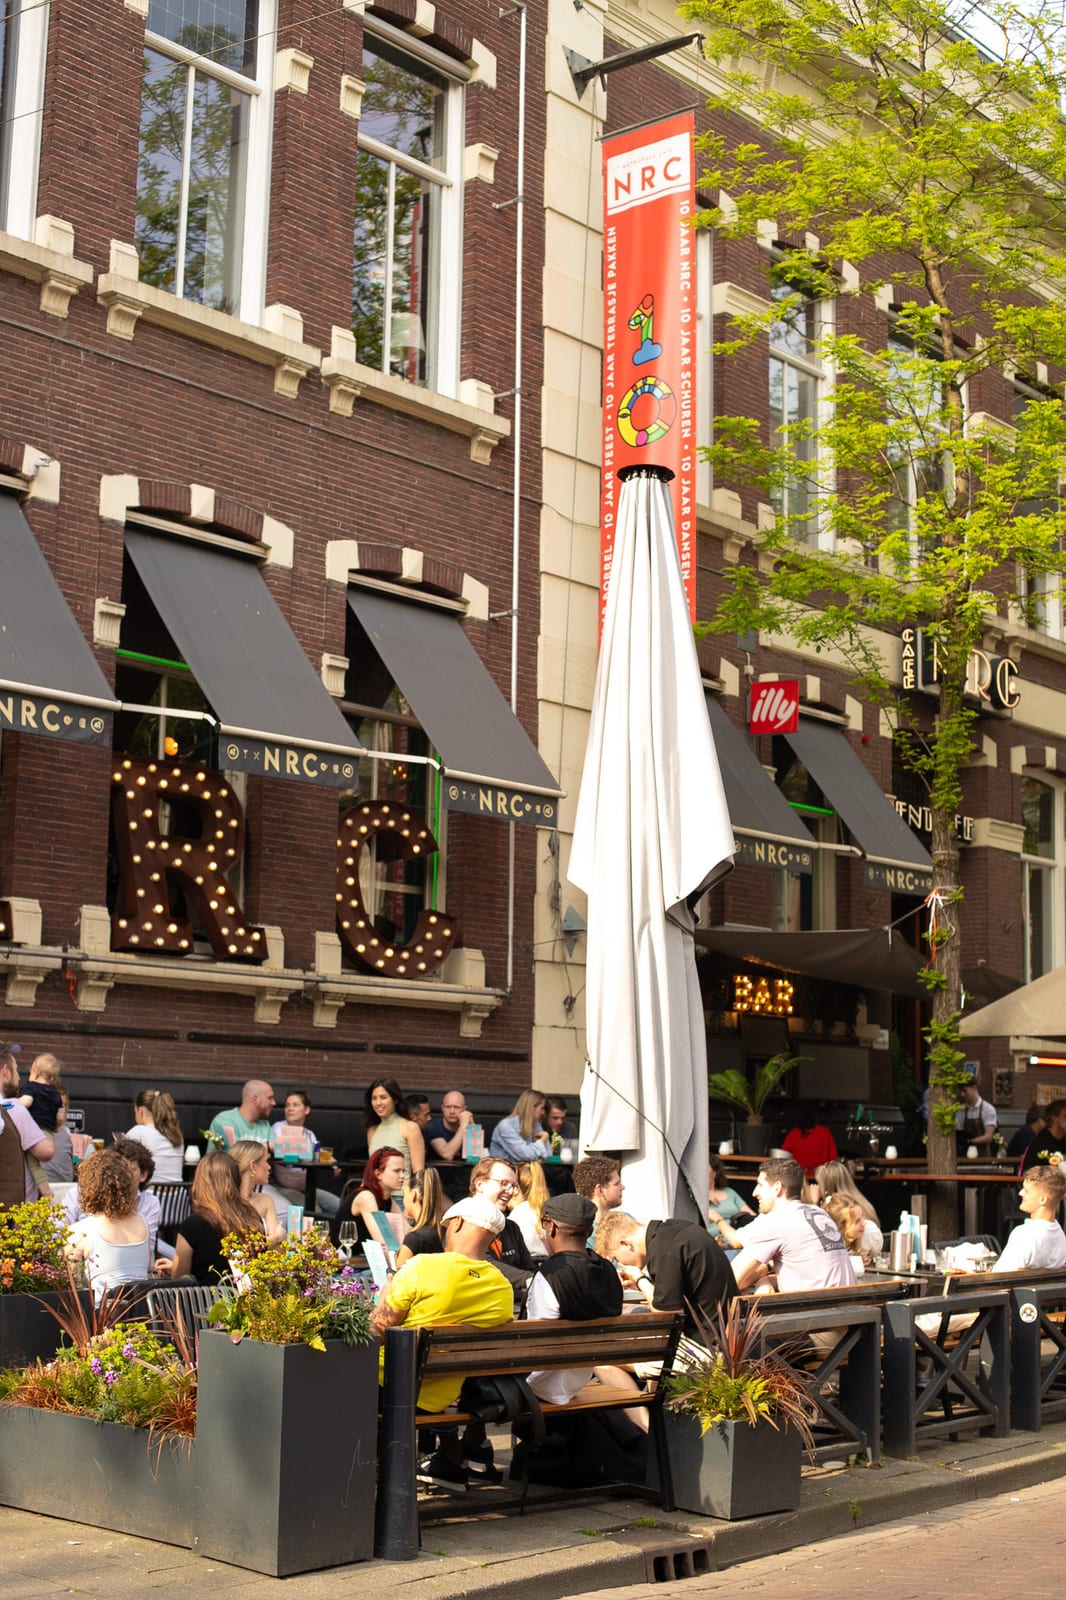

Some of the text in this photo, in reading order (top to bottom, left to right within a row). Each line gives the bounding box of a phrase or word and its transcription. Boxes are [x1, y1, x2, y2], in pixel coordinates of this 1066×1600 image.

[614, 156, 682, 201] NRC
[608, 226, 616, 278] PAKKEN
[680, 220, 690, 256] JAAR
[680, 261, 691, 290] NRC
[606, 282, 616, 350] TERRASJE
[681, 308, 691, 323] 10
[681, 329, 691, 365] JAAR
[606, 353, 615, 388] JAAR
[606, 394, 614, 409] 10
[681, 371, 691, 438] SCHUREN
[605, 427, 614, 467] FEEST
[681, 456, 692, 472] 10
[604, 471, 613, 507] JAAR
[681, 478, 691, 516] JAAR
[604, 513, 613, 529] 10
[681, 521, 691, 580] DANSEN
[0, 696, 61, 732] NRC
[752, 687, 797, 730] illy
[263, 745, 319, 778] NRC
[479, 788, 524, 818] NRC
[755, 842, 788, 867] NRC
[886, 868, 915, 891] NRC
[734, 976, 794, 1015] BAR
